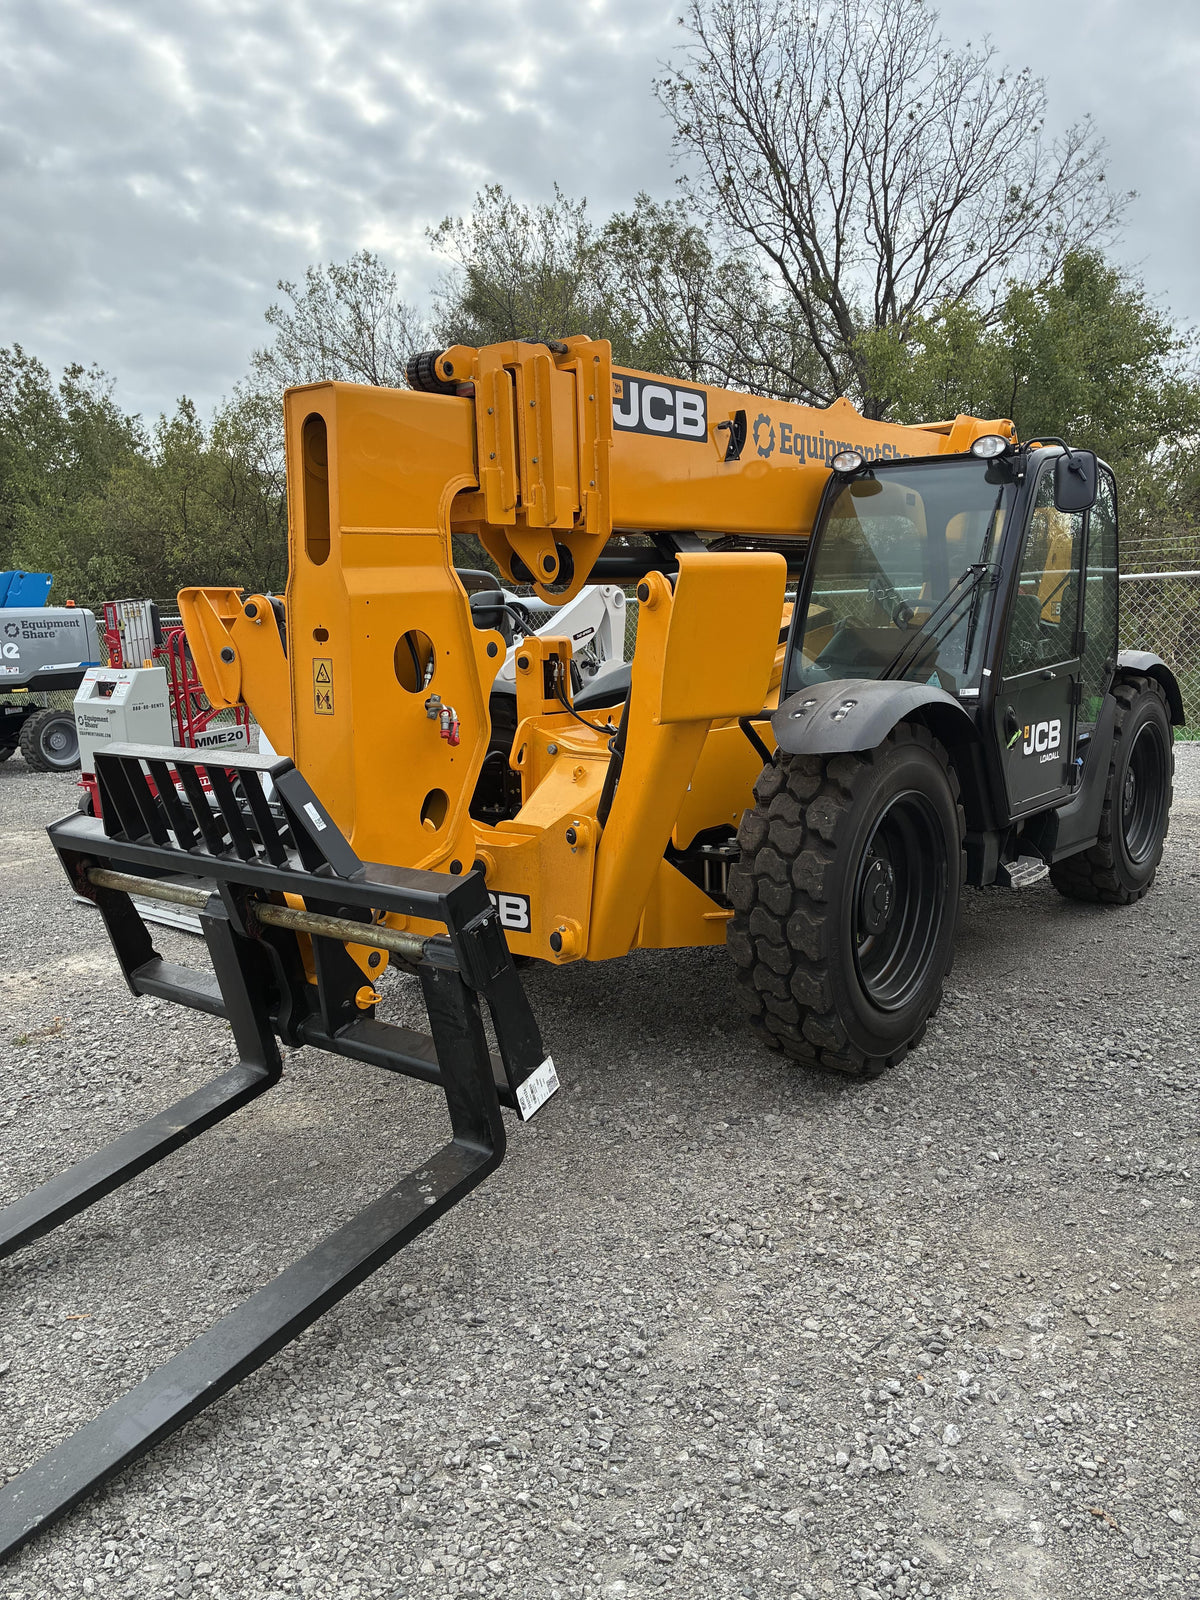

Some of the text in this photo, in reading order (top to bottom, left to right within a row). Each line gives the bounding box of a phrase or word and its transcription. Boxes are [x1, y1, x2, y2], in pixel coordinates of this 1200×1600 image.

[612, 381, 706, 437] JCB
[21, 619, 80, 630] Equipment
[22, 630, 56, 639] Share
[195, 730, 244, 748] MME20
[1023, 719, 1061, 755] JCB
[1039, 750, 1060, 763] LOADALL
